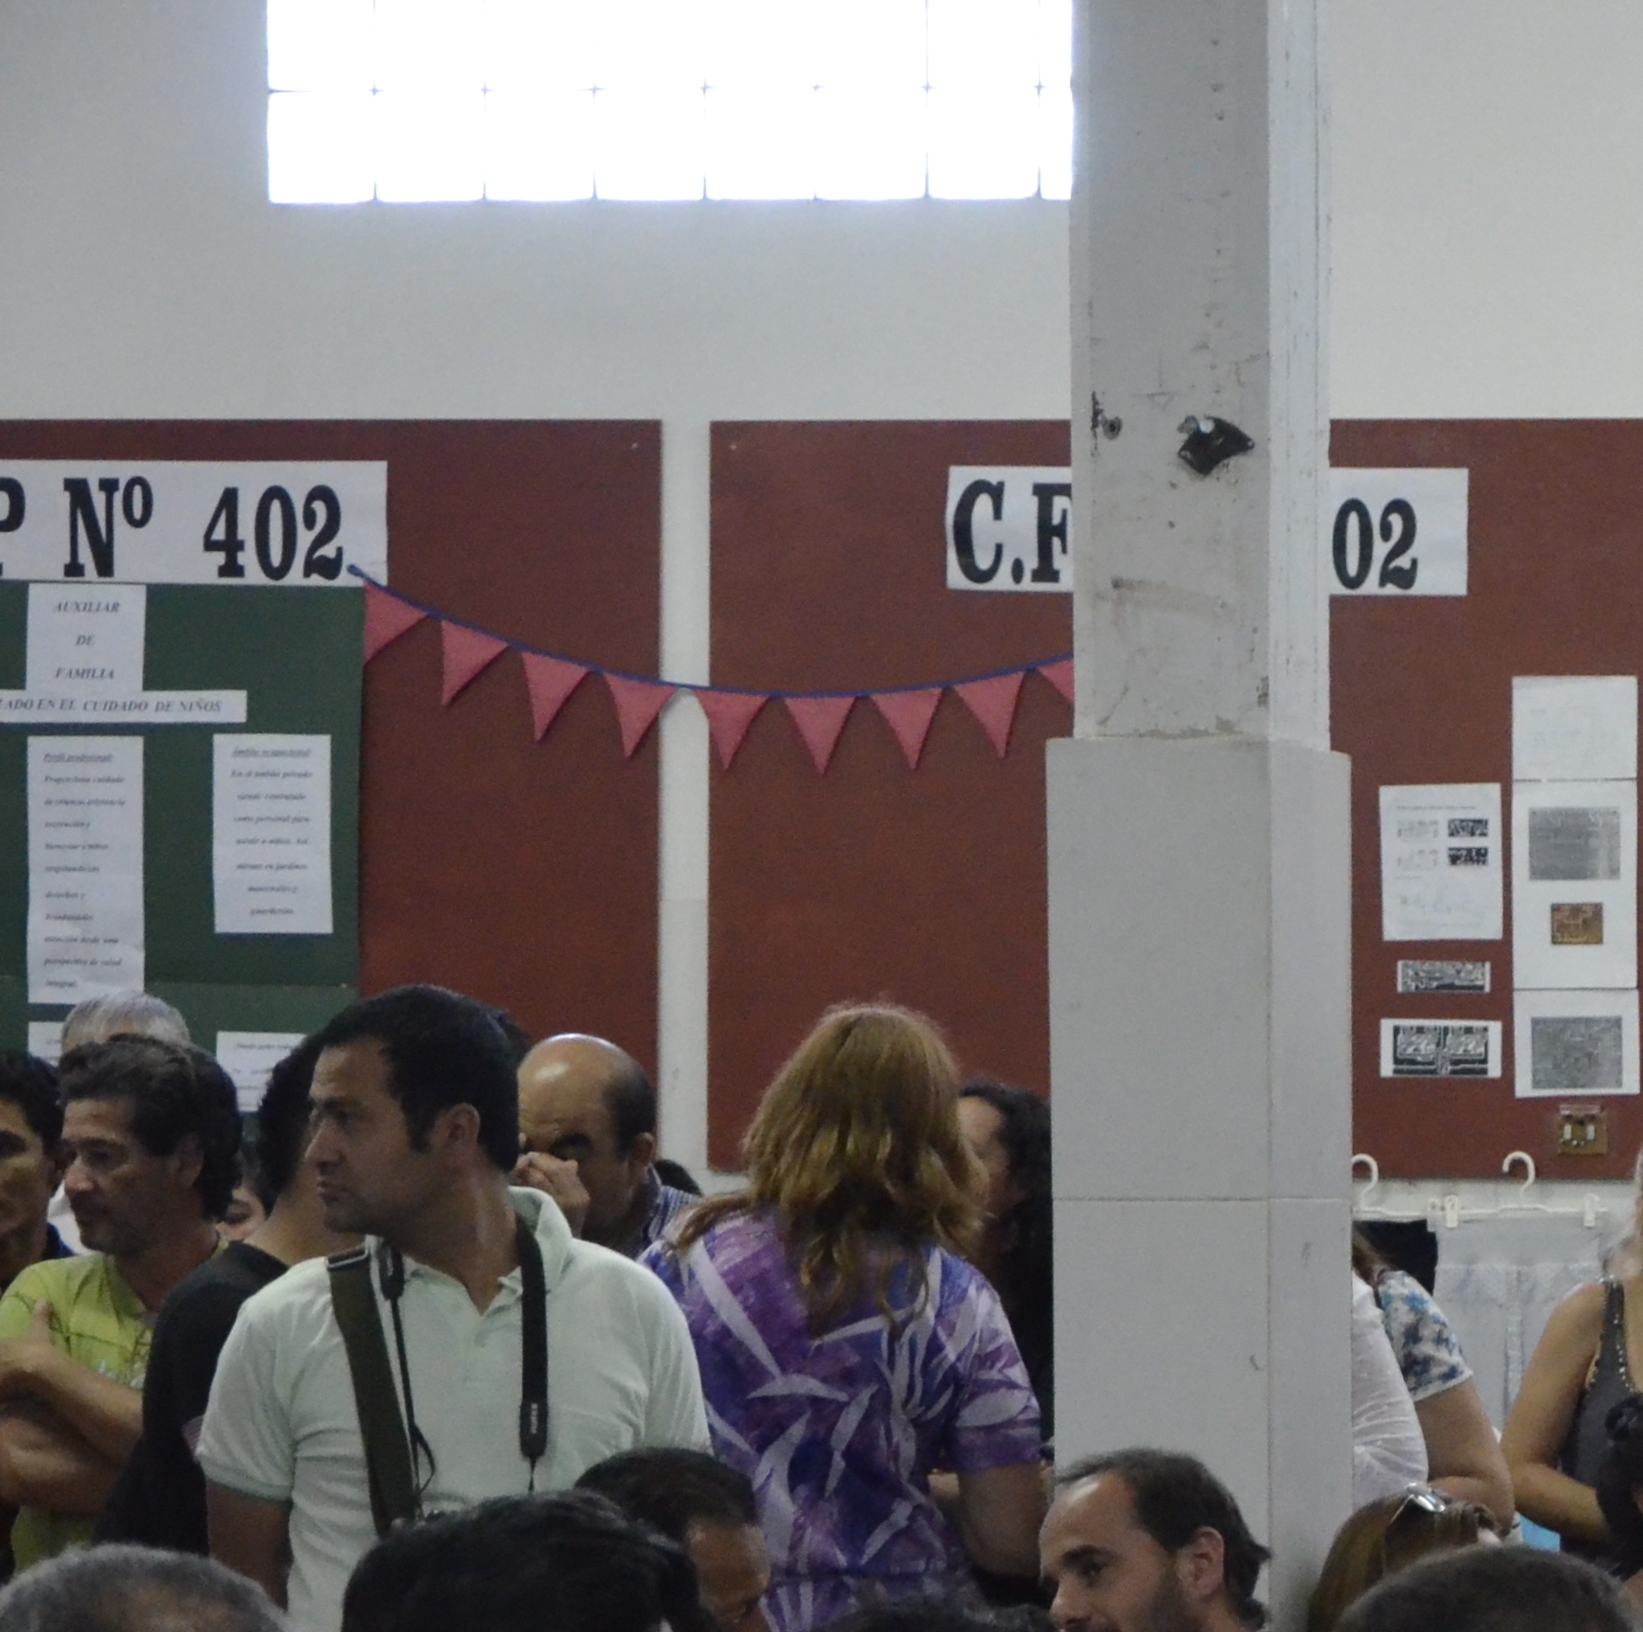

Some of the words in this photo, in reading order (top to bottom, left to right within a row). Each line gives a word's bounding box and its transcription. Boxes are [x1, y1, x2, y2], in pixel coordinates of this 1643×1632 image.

[203, 484, 343, 581] 402
[1332, 497, 1418, 590] 02
[53, 601, 121, 613] AUXILIAR
[75, 635, 96, 646] DE
[55, 668, 115, 679] FAMILIA
[0, 699, 33, 710] ADO
[36, 699, 56, 710] EN
[59, 699, 77, 710] EL
[83, 700, 148, 711] CUIDADO
[155, 701, 175, 712] DE
[176, 699, 223, 712] NIÑOS
